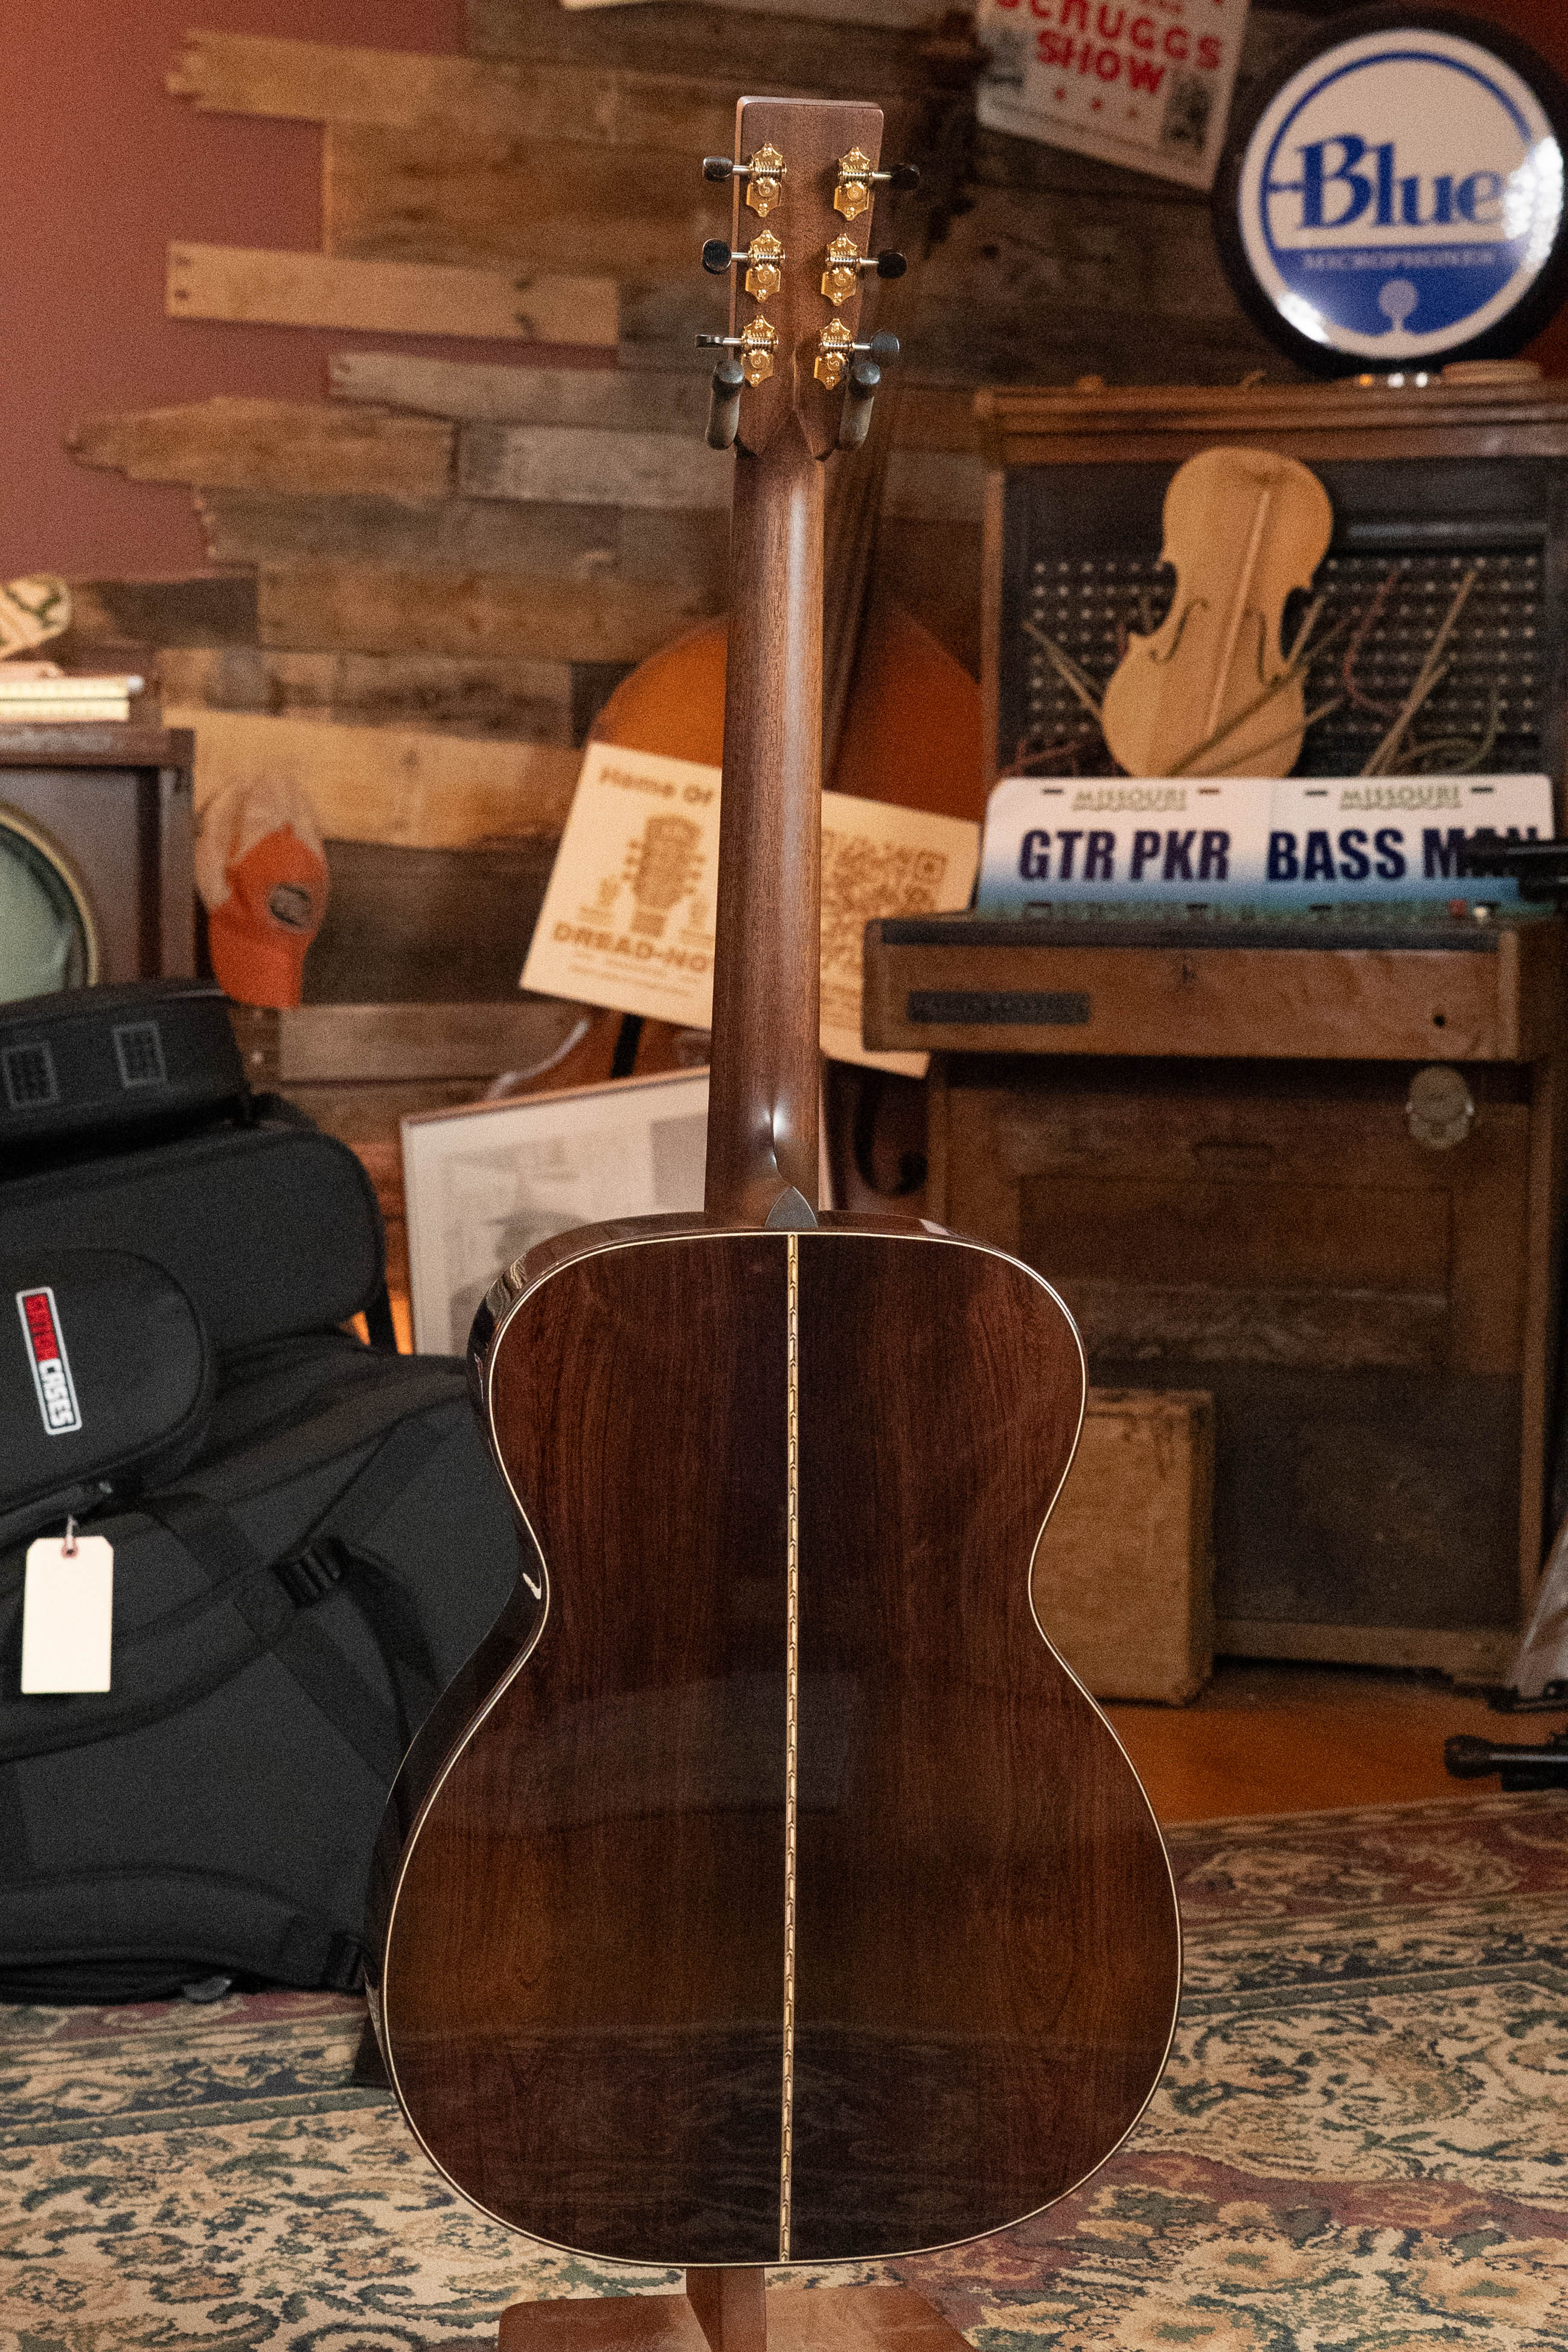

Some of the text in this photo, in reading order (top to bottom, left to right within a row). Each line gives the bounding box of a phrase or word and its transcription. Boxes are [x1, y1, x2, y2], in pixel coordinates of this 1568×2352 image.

[997, 0, 1221, 71] CRUGGS
[1035, 29, 1166, 95] SHOW
[1294, 133, 1513, 230] Blue
[1070, 787, 1188, 812] MISSOURI
[1339, 786, 1464, 810] MISSOURI
[1018, 827, 1232, 882] GTR PKR
[1266, 828, 1408, 882] BASS
[39, 1359, 75, 1426] CASES
